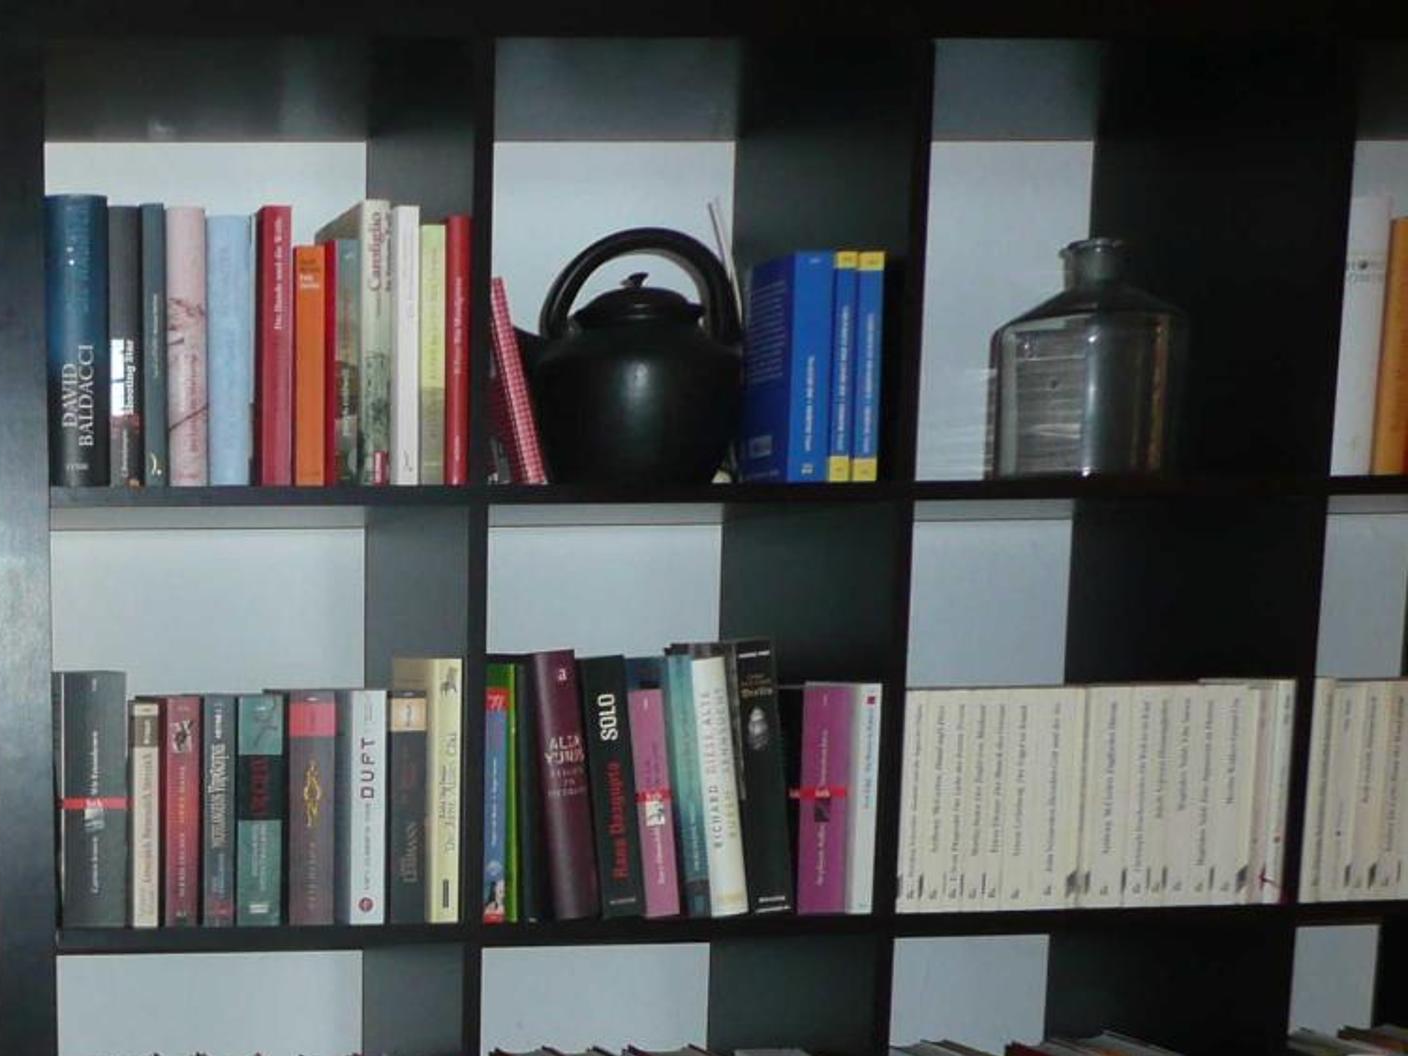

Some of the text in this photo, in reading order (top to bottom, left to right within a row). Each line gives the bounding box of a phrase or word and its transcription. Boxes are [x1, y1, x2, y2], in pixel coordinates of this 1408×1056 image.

[62, 363, 77, 428] DAVID
[78, 344, 95, 447] BALDACCI
[596, 693, 617, 741] SOLO
[359, 737, 375, 800] DUFT
